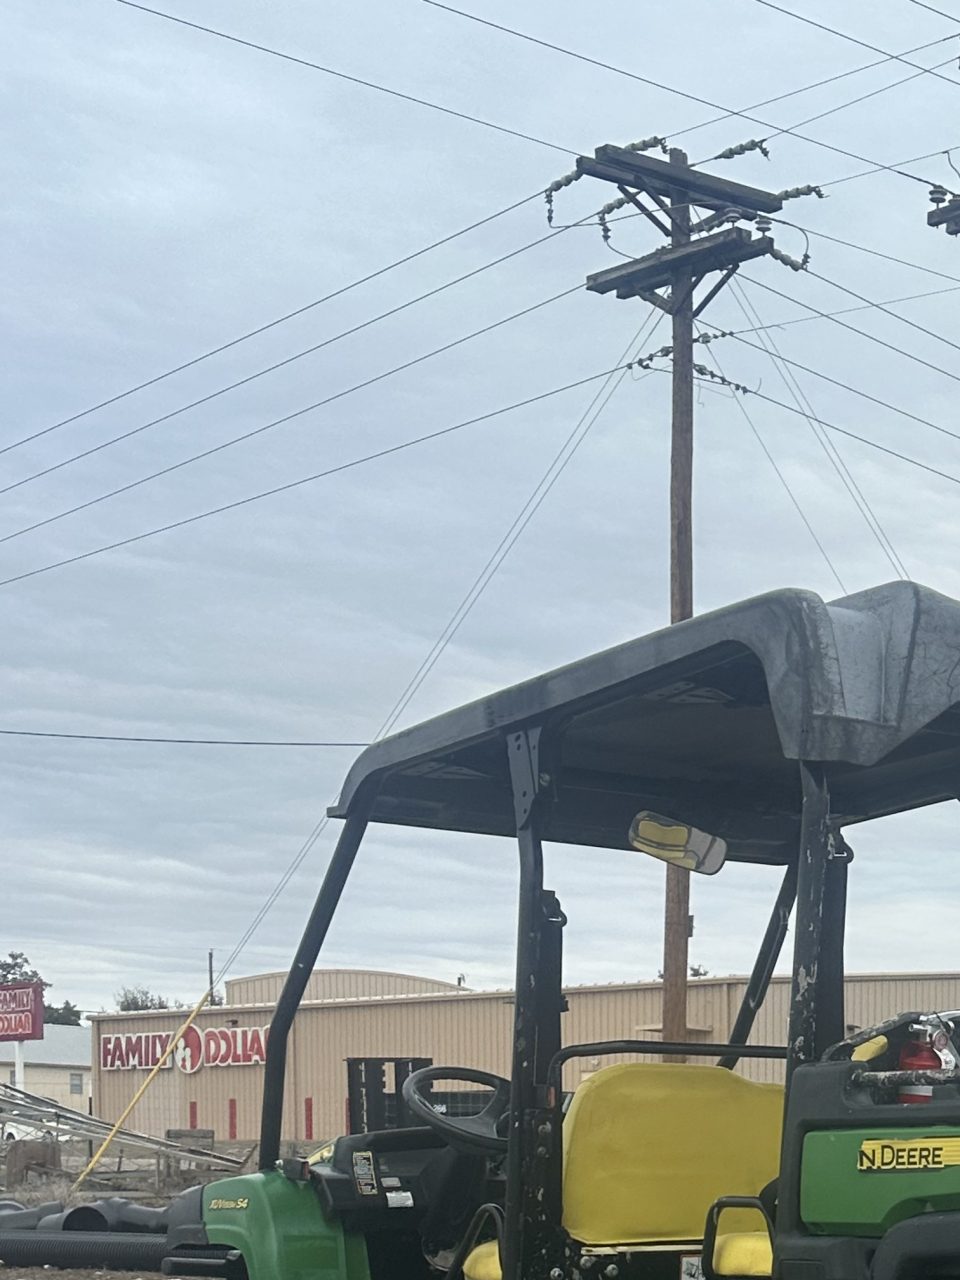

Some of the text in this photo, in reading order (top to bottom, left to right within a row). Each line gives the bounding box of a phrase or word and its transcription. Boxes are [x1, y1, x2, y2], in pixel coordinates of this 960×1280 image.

[0, 989, 32, 1011] AMILY
[101, 1025, 271, 1070] FAMILY DOLLA
[880, 1144, 944, 1167] DEERE
